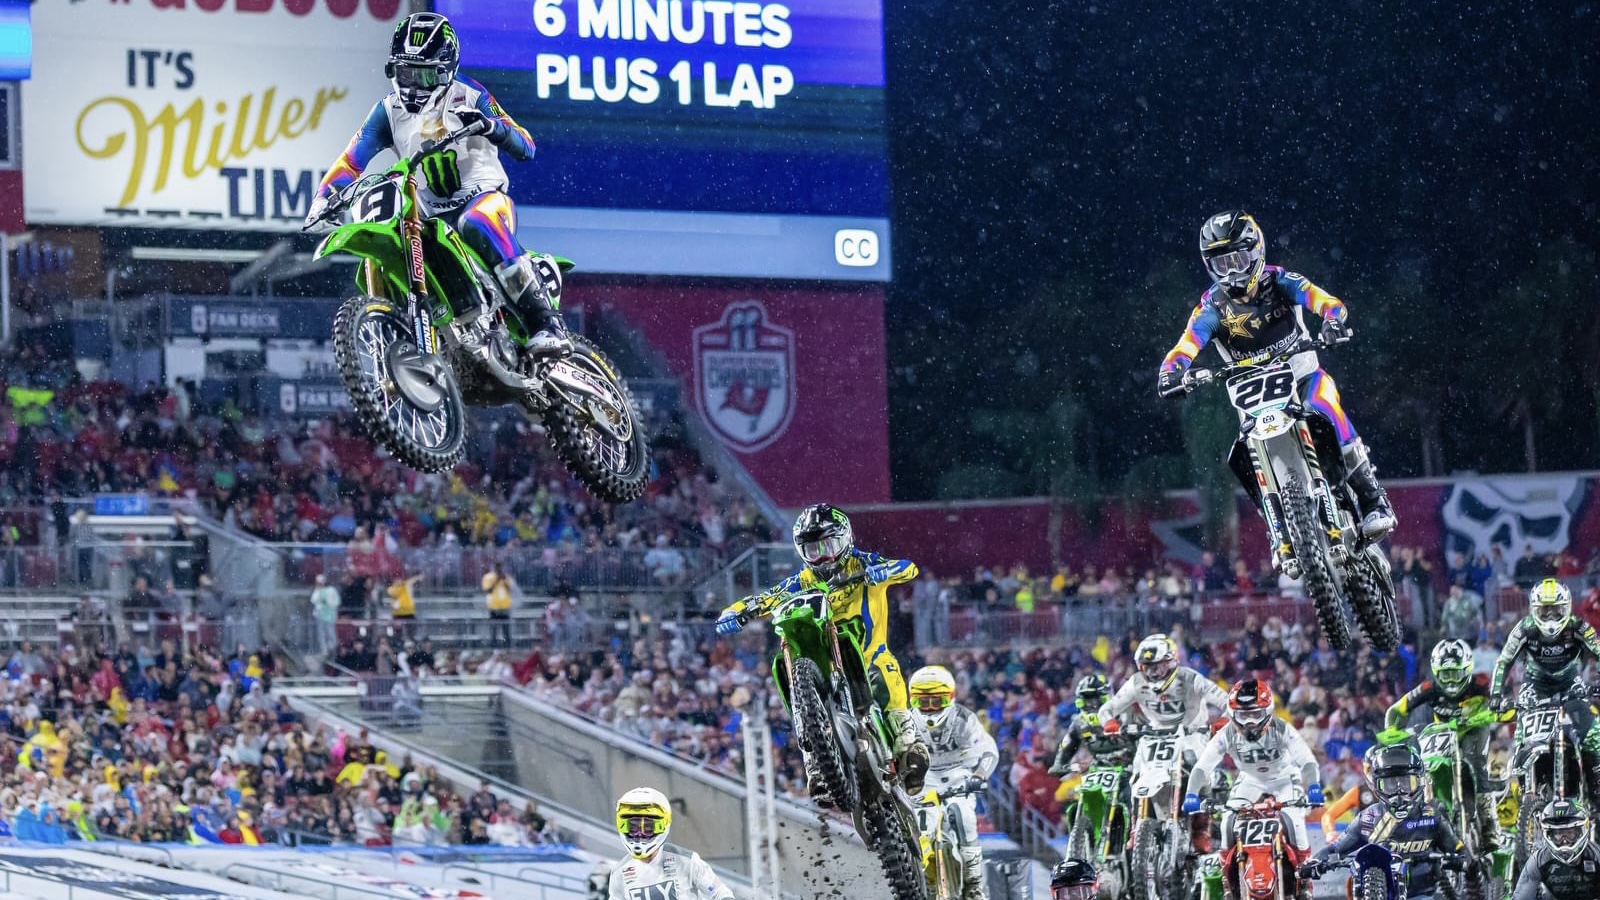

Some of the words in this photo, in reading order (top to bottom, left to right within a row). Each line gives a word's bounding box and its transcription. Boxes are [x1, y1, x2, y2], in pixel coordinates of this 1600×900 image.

[533, 0, 567, 37] 6
[578, 0, 793, 48] MINUTES
[126, 49, 195, 88] IT'S
[536, 53, 660, 104] PLUS
[669, 61, 692, 105] 1
[703, 62, 794, 109] LAP
[76, 86, 348, 210] Miller
[219, 167, 328, 219] TIM
[360, 181, 398, 222] 9
[840, 237, 872, 260] CC
[420, 309, 433, 355] DUNLOP
[1235, 372, 1294, 411] 28
[1524, 711, 1557, 738] 219
[1145, 741, 1176, 762] 15
[1238, 820, 1280, 845] 129
